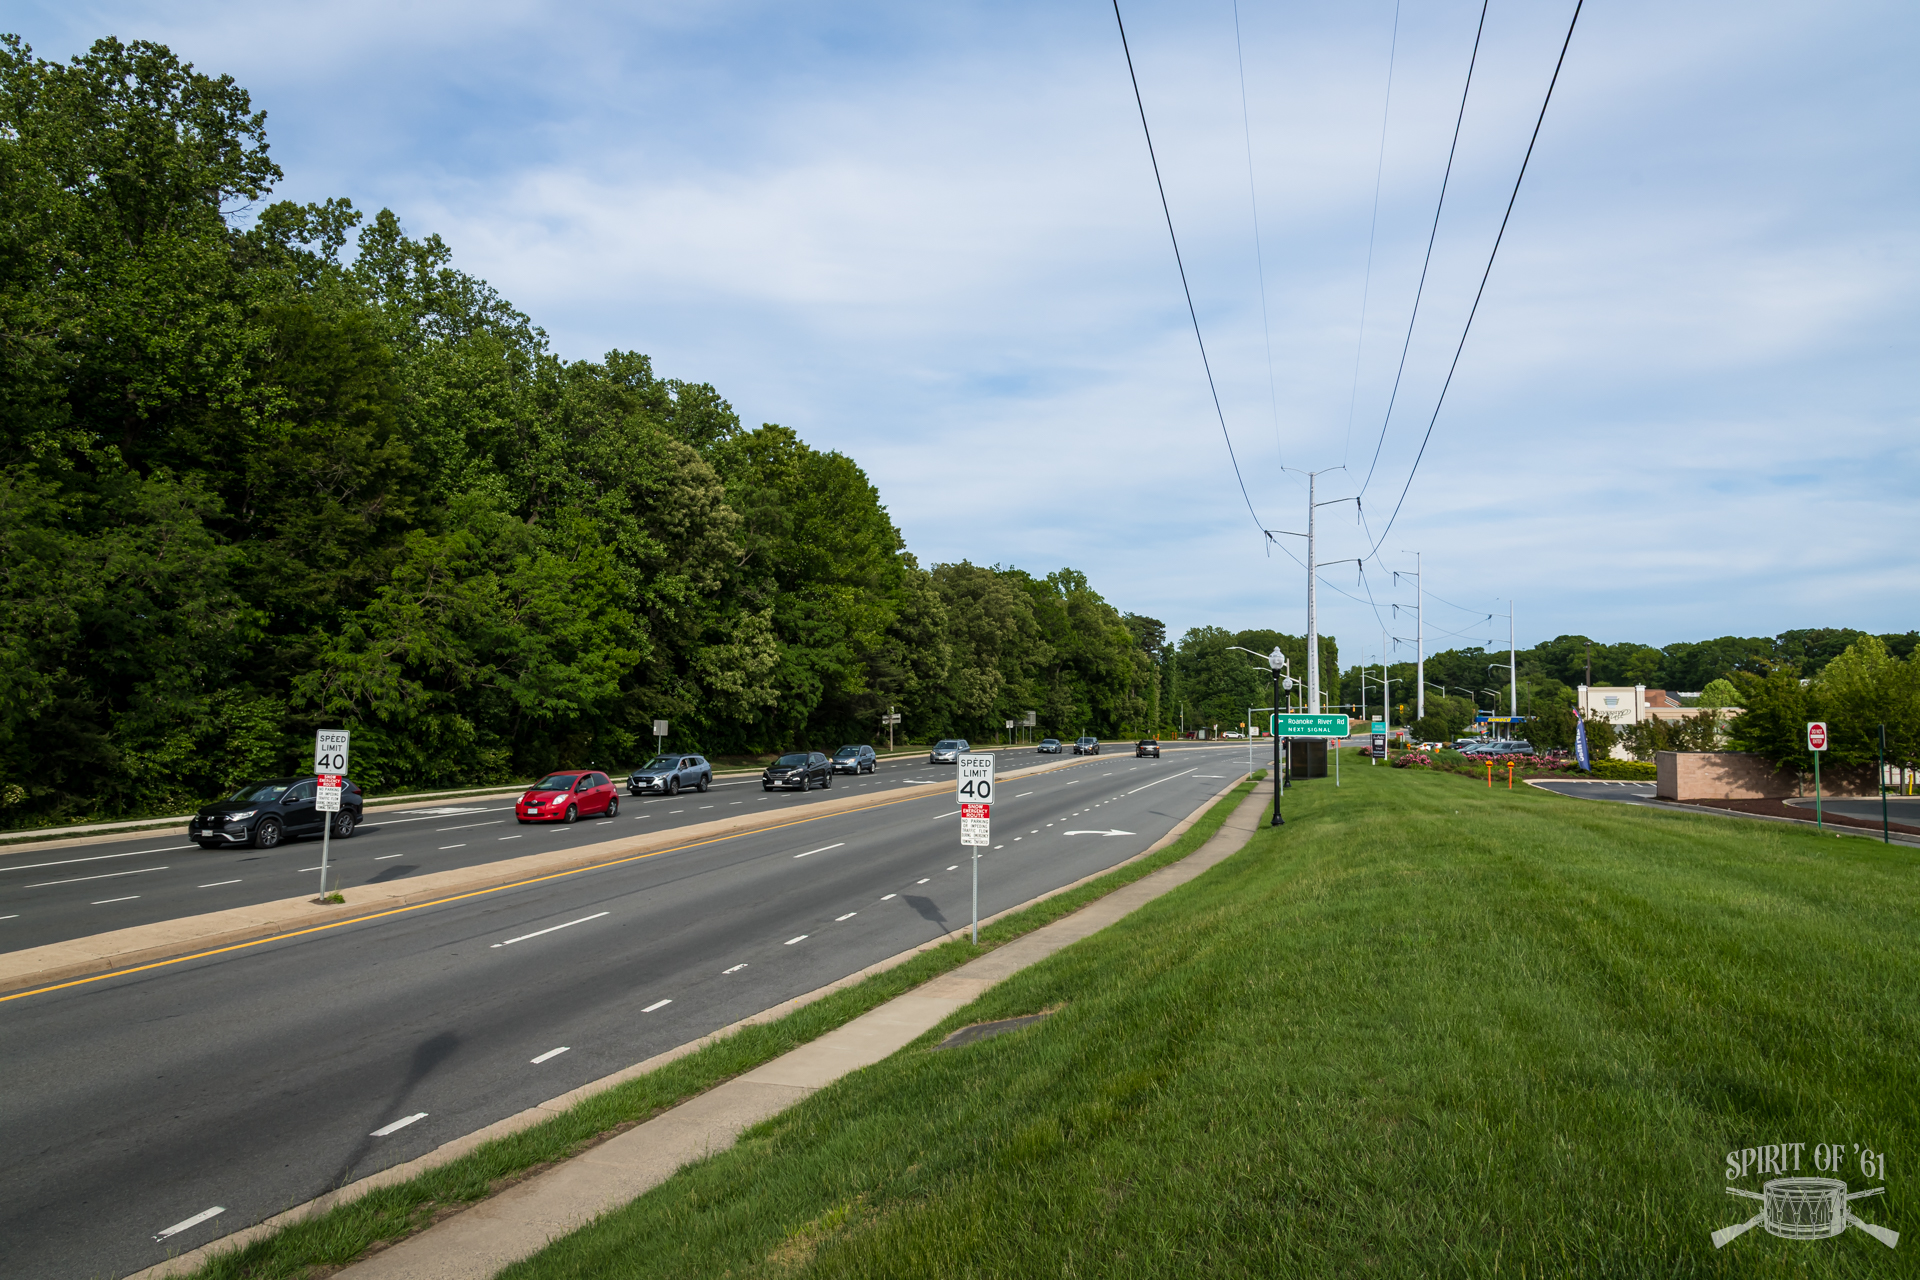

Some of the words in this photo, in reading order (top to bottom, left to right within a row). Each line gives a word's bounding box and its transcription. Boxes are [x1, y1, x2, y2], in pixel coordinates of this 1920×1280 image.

[320, 735, 346, 743] SPEED
[318, 754, 344, 769] 40
[960, 759, 991, 767] SPEED
[960, 780, 990, 798] 40
